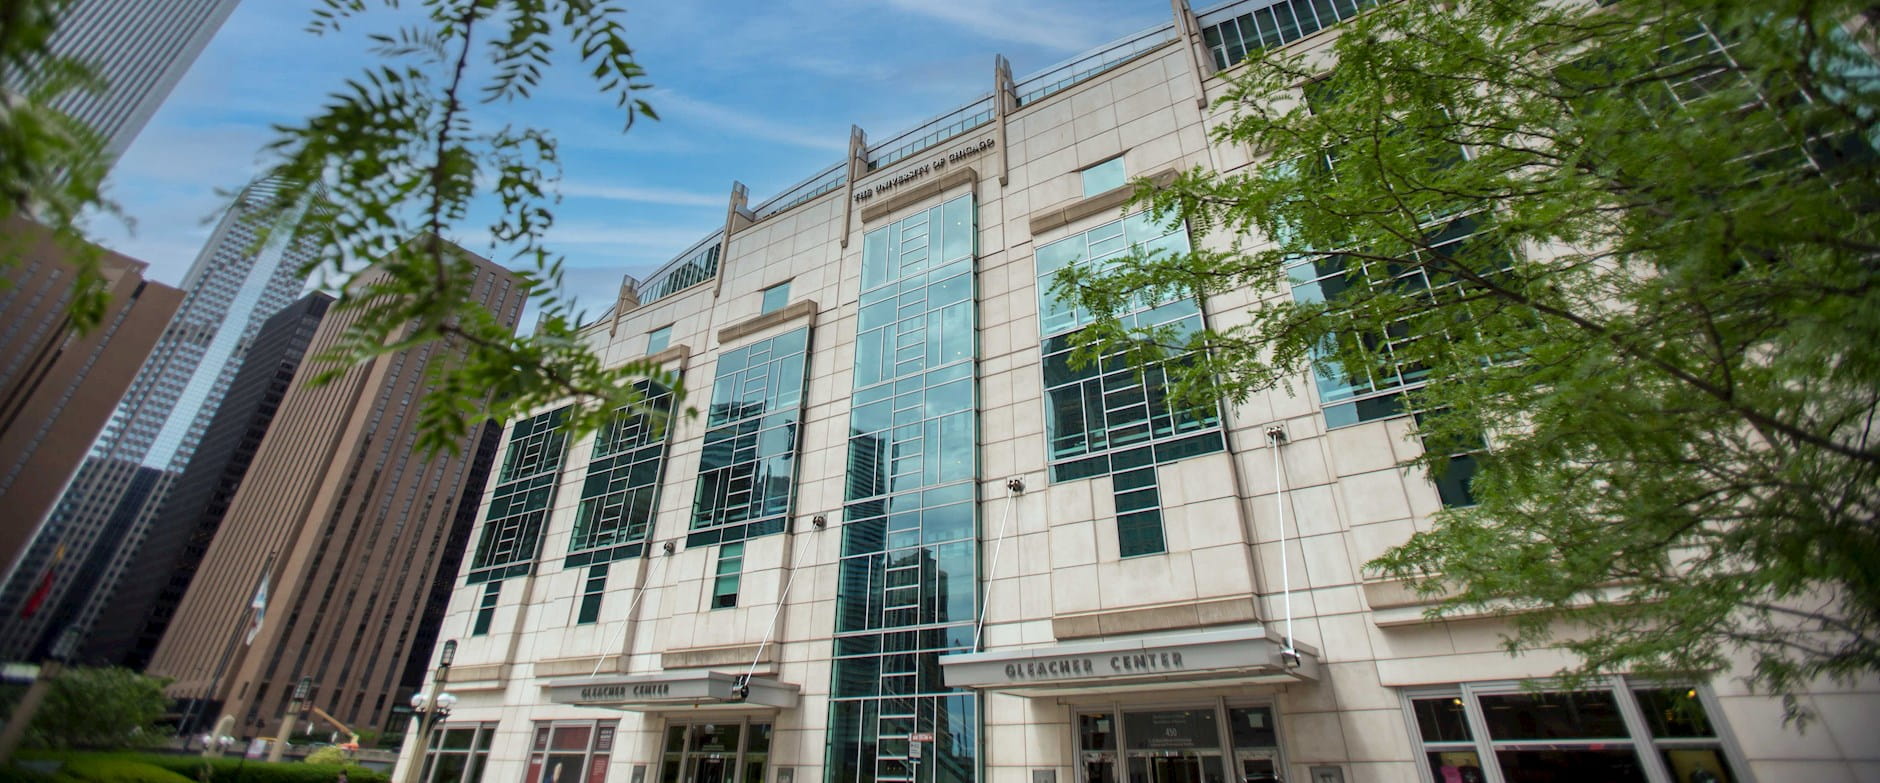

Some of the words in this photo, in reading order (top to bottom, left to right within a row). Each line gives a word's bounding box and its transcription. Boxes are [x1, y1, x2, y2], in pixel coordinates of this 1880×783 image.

[1005, 658, 1094, 678] GLEACHER
[1110, 652, 1183, 671] CENTER
[581, 686, 626, 698] GLEACHER
[633, 684, 669, 696] CENTER
